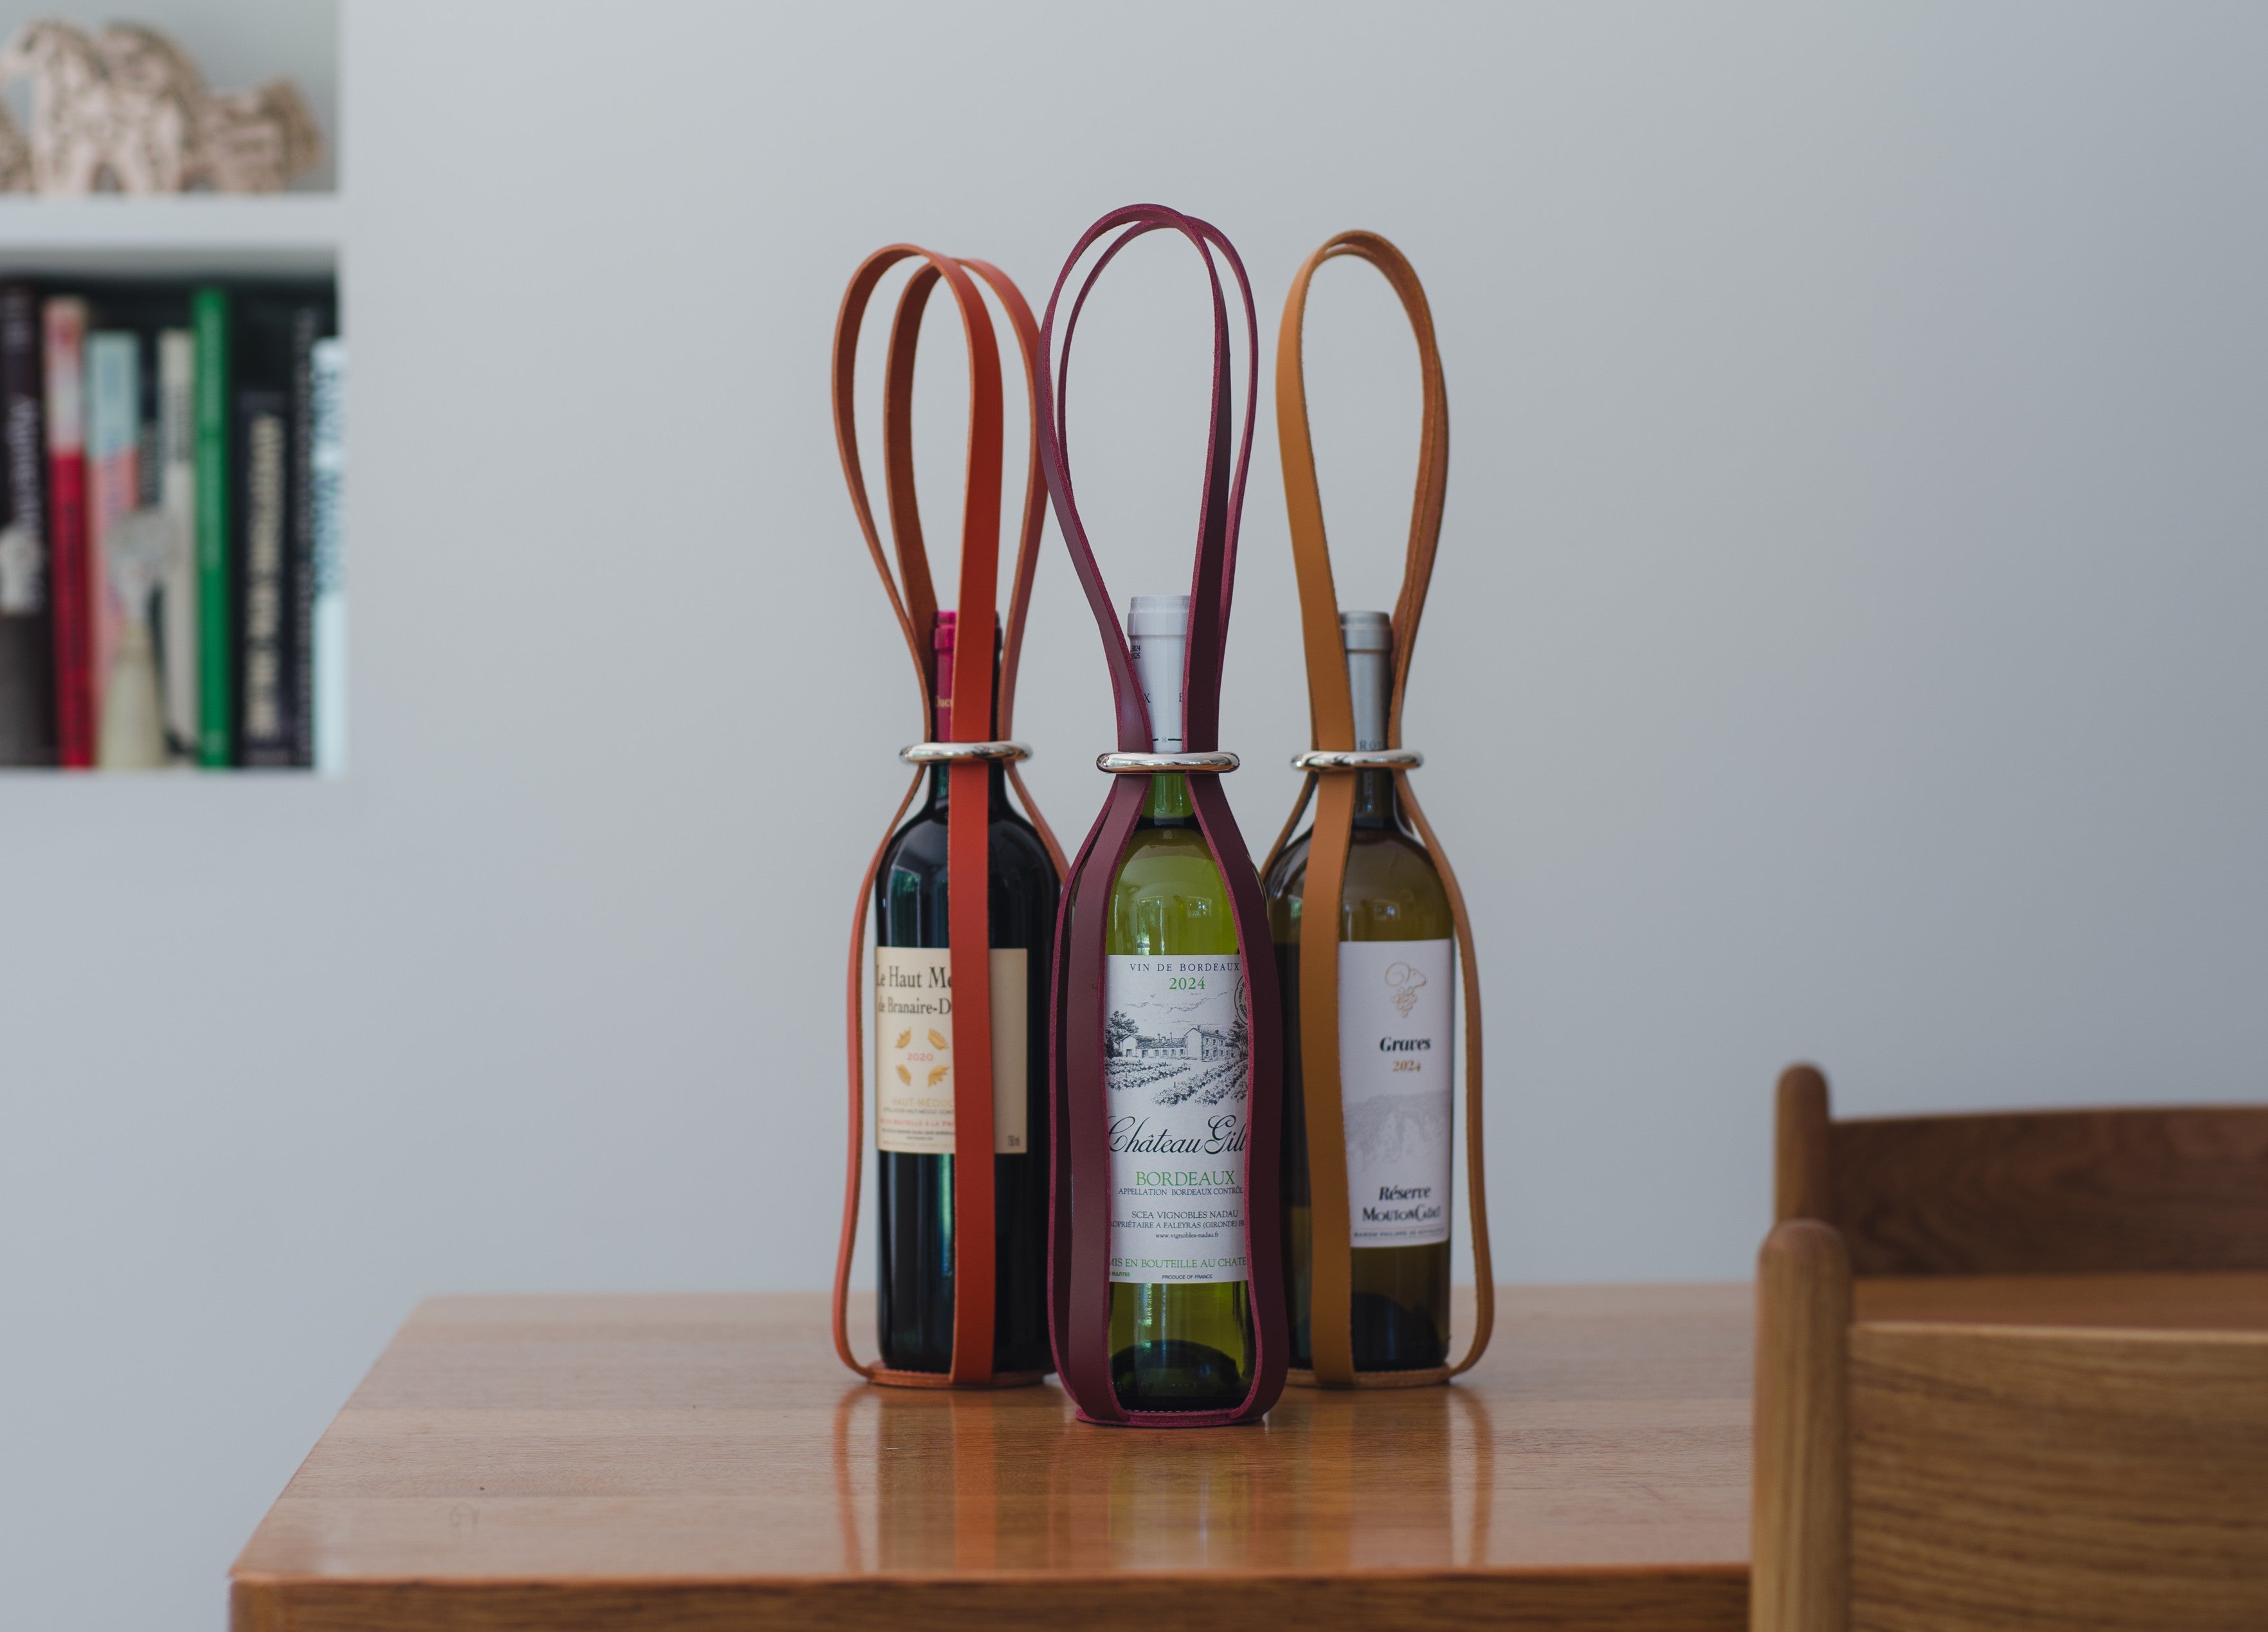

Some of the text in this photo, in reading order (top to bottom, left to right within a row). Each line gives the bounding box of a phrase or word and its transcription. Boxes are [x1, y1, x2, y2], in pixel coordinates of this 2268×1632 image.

[1130, 963, 1240, 972] VIN DE BORDEAUX
[889, 966, 922, 988] Haut
[1169, 976, 1206, 990] 2024
[1380, 1037, 1432, 1052] Graves
[907, 1053, 933, 1061] 2020
[1392, 1060, 1421, 1072] 2024
[1108, 1115, 1203, 1154] Château
[1135, 1170, 1236, 1186] BORDEAUX
[1378, 1184, 1432, 1201] Réserve
[1210, 1210, 1239, 1218] NADAU
[1203, 1220, 1238, 1229] (GIRONDE)
[1125, 1258, 1138, 1267] EN
[1141, 1259, 1198, 1268] BOUTEILLE
[1201, 1259, 1215, 1268] AU
